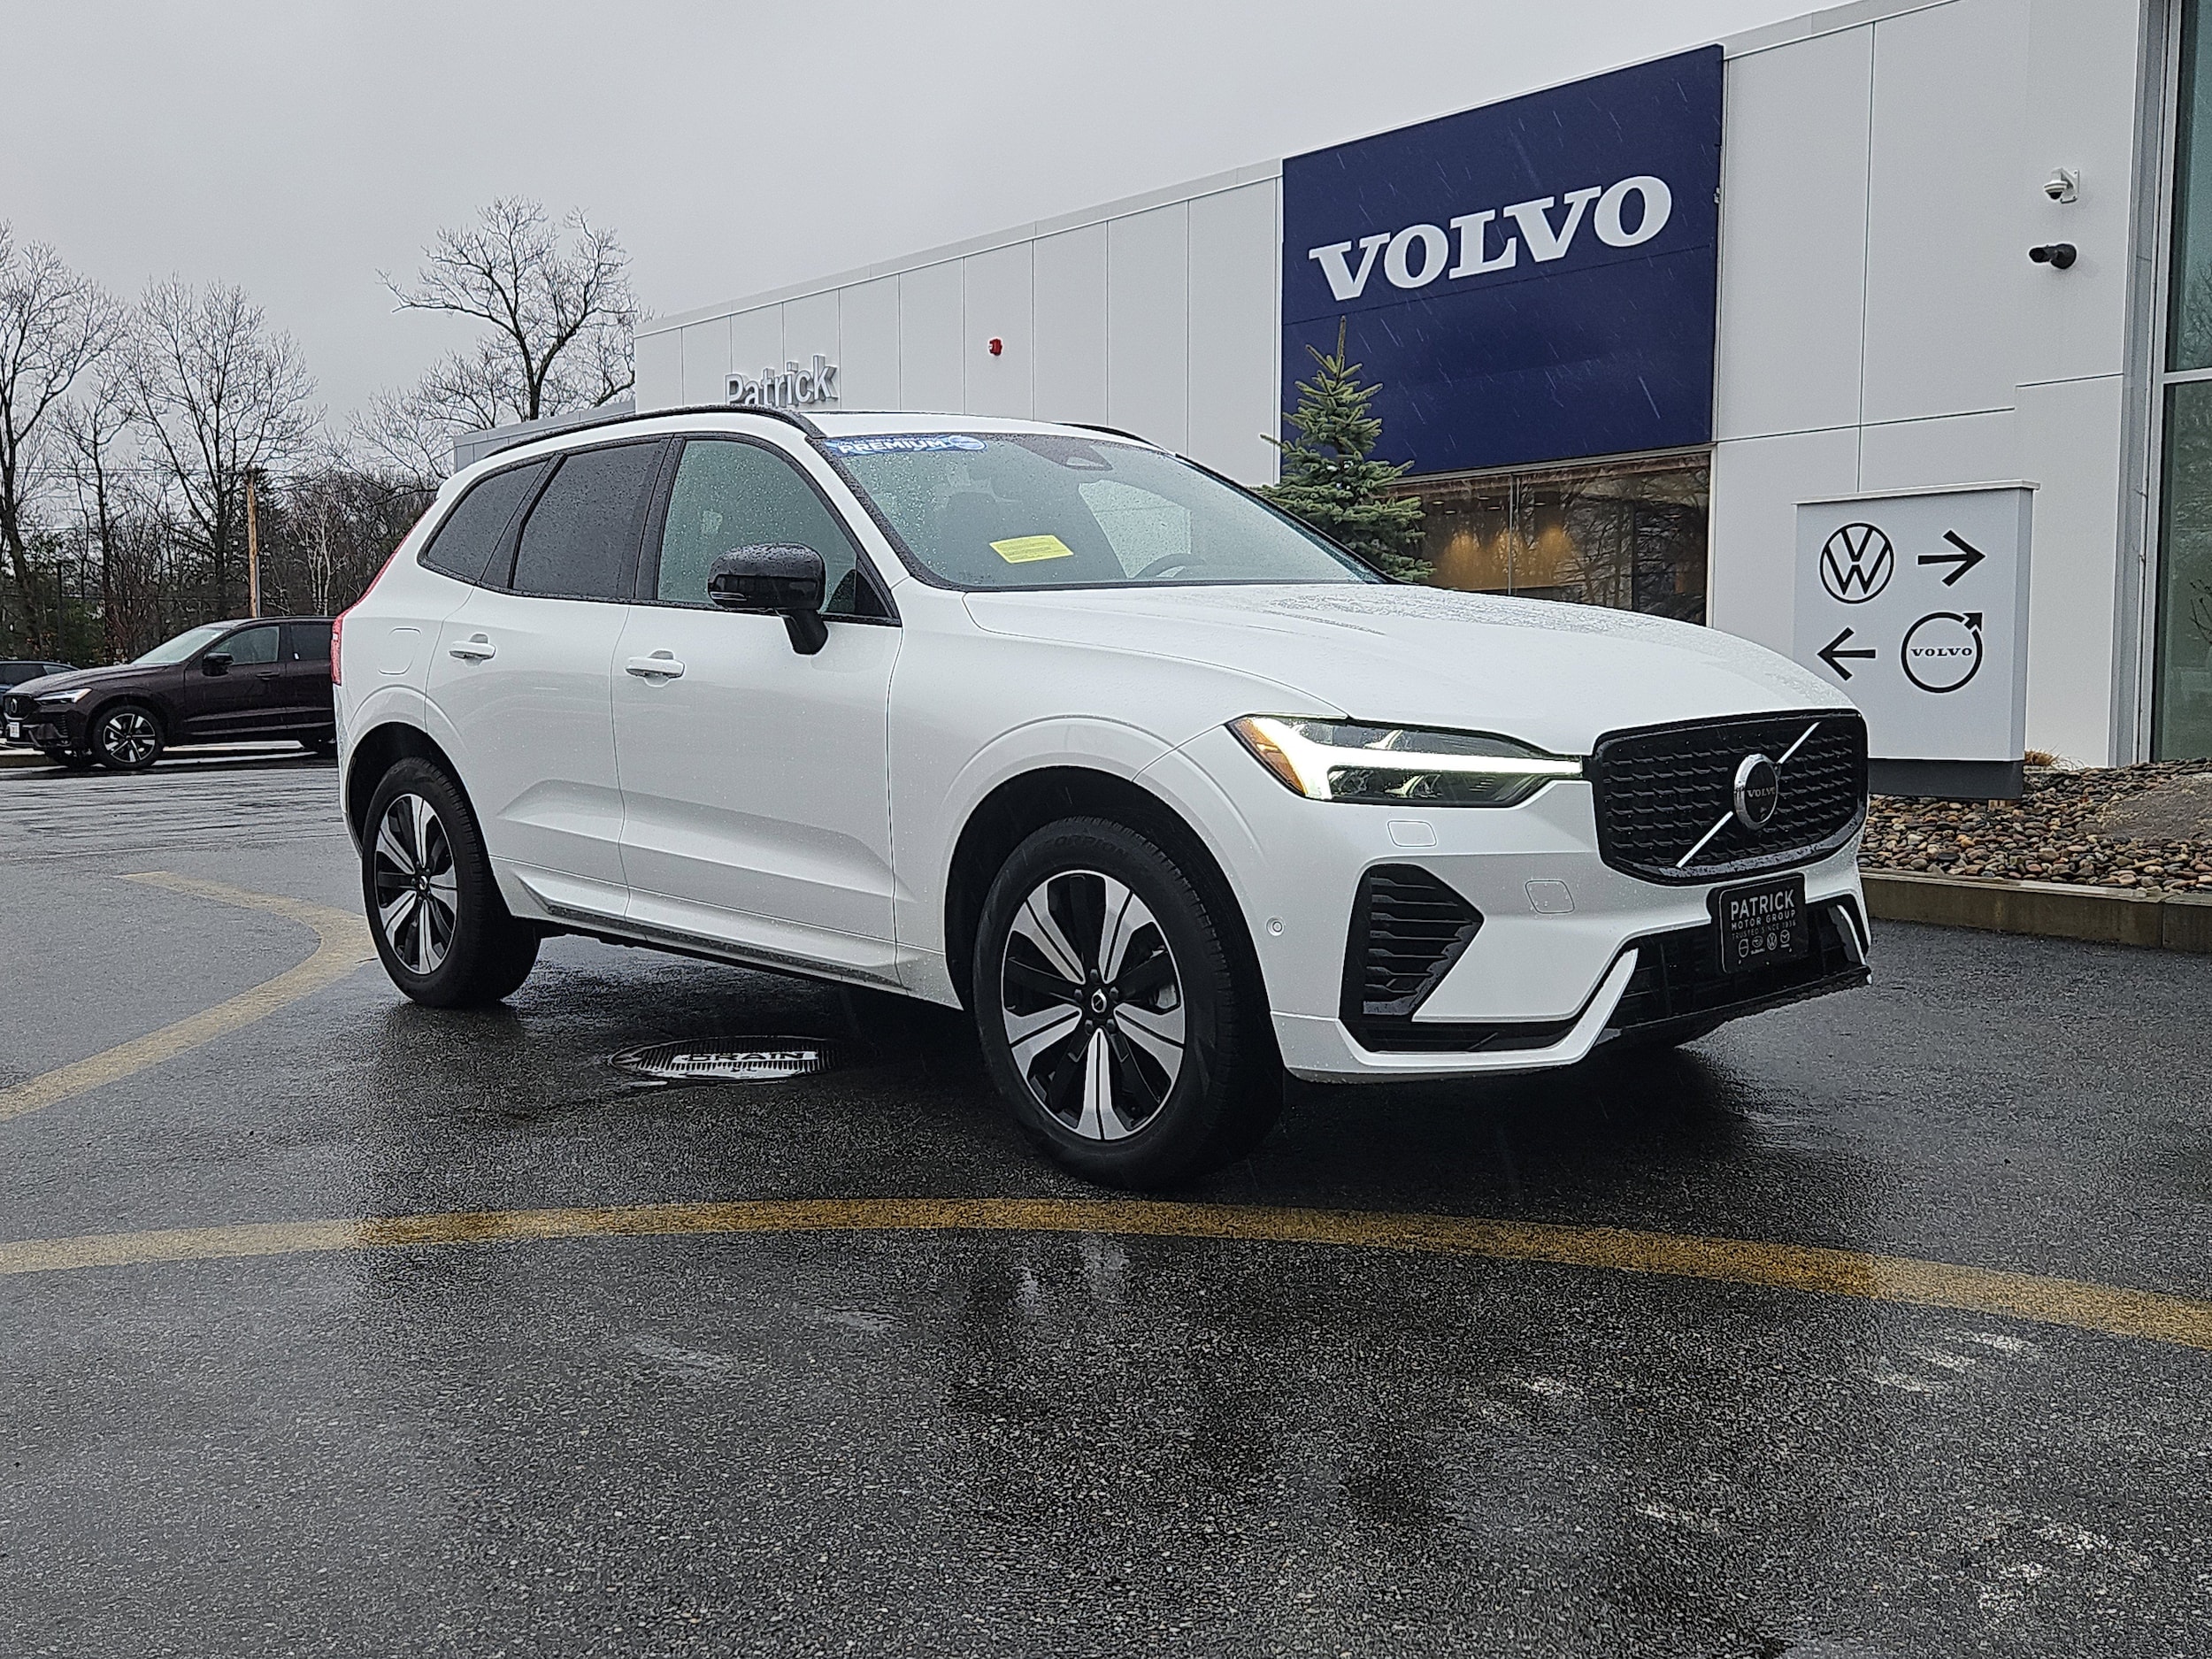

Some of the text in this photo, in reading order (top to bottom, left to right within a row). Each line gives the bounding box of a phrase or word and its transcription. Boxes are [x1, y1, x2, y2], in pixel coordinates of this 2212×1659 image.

[1309, 176, 1672, 301] VOLVO
[725, 354, 838, 407] Patrick
[838, 440, 948, 454] PREMIUM
[1910, 647, 1973, 657] VOLVO
[1731, 888, 1794, 921] PATRICK
[1731, 909, 1796, 931] MOTOR GROUP
